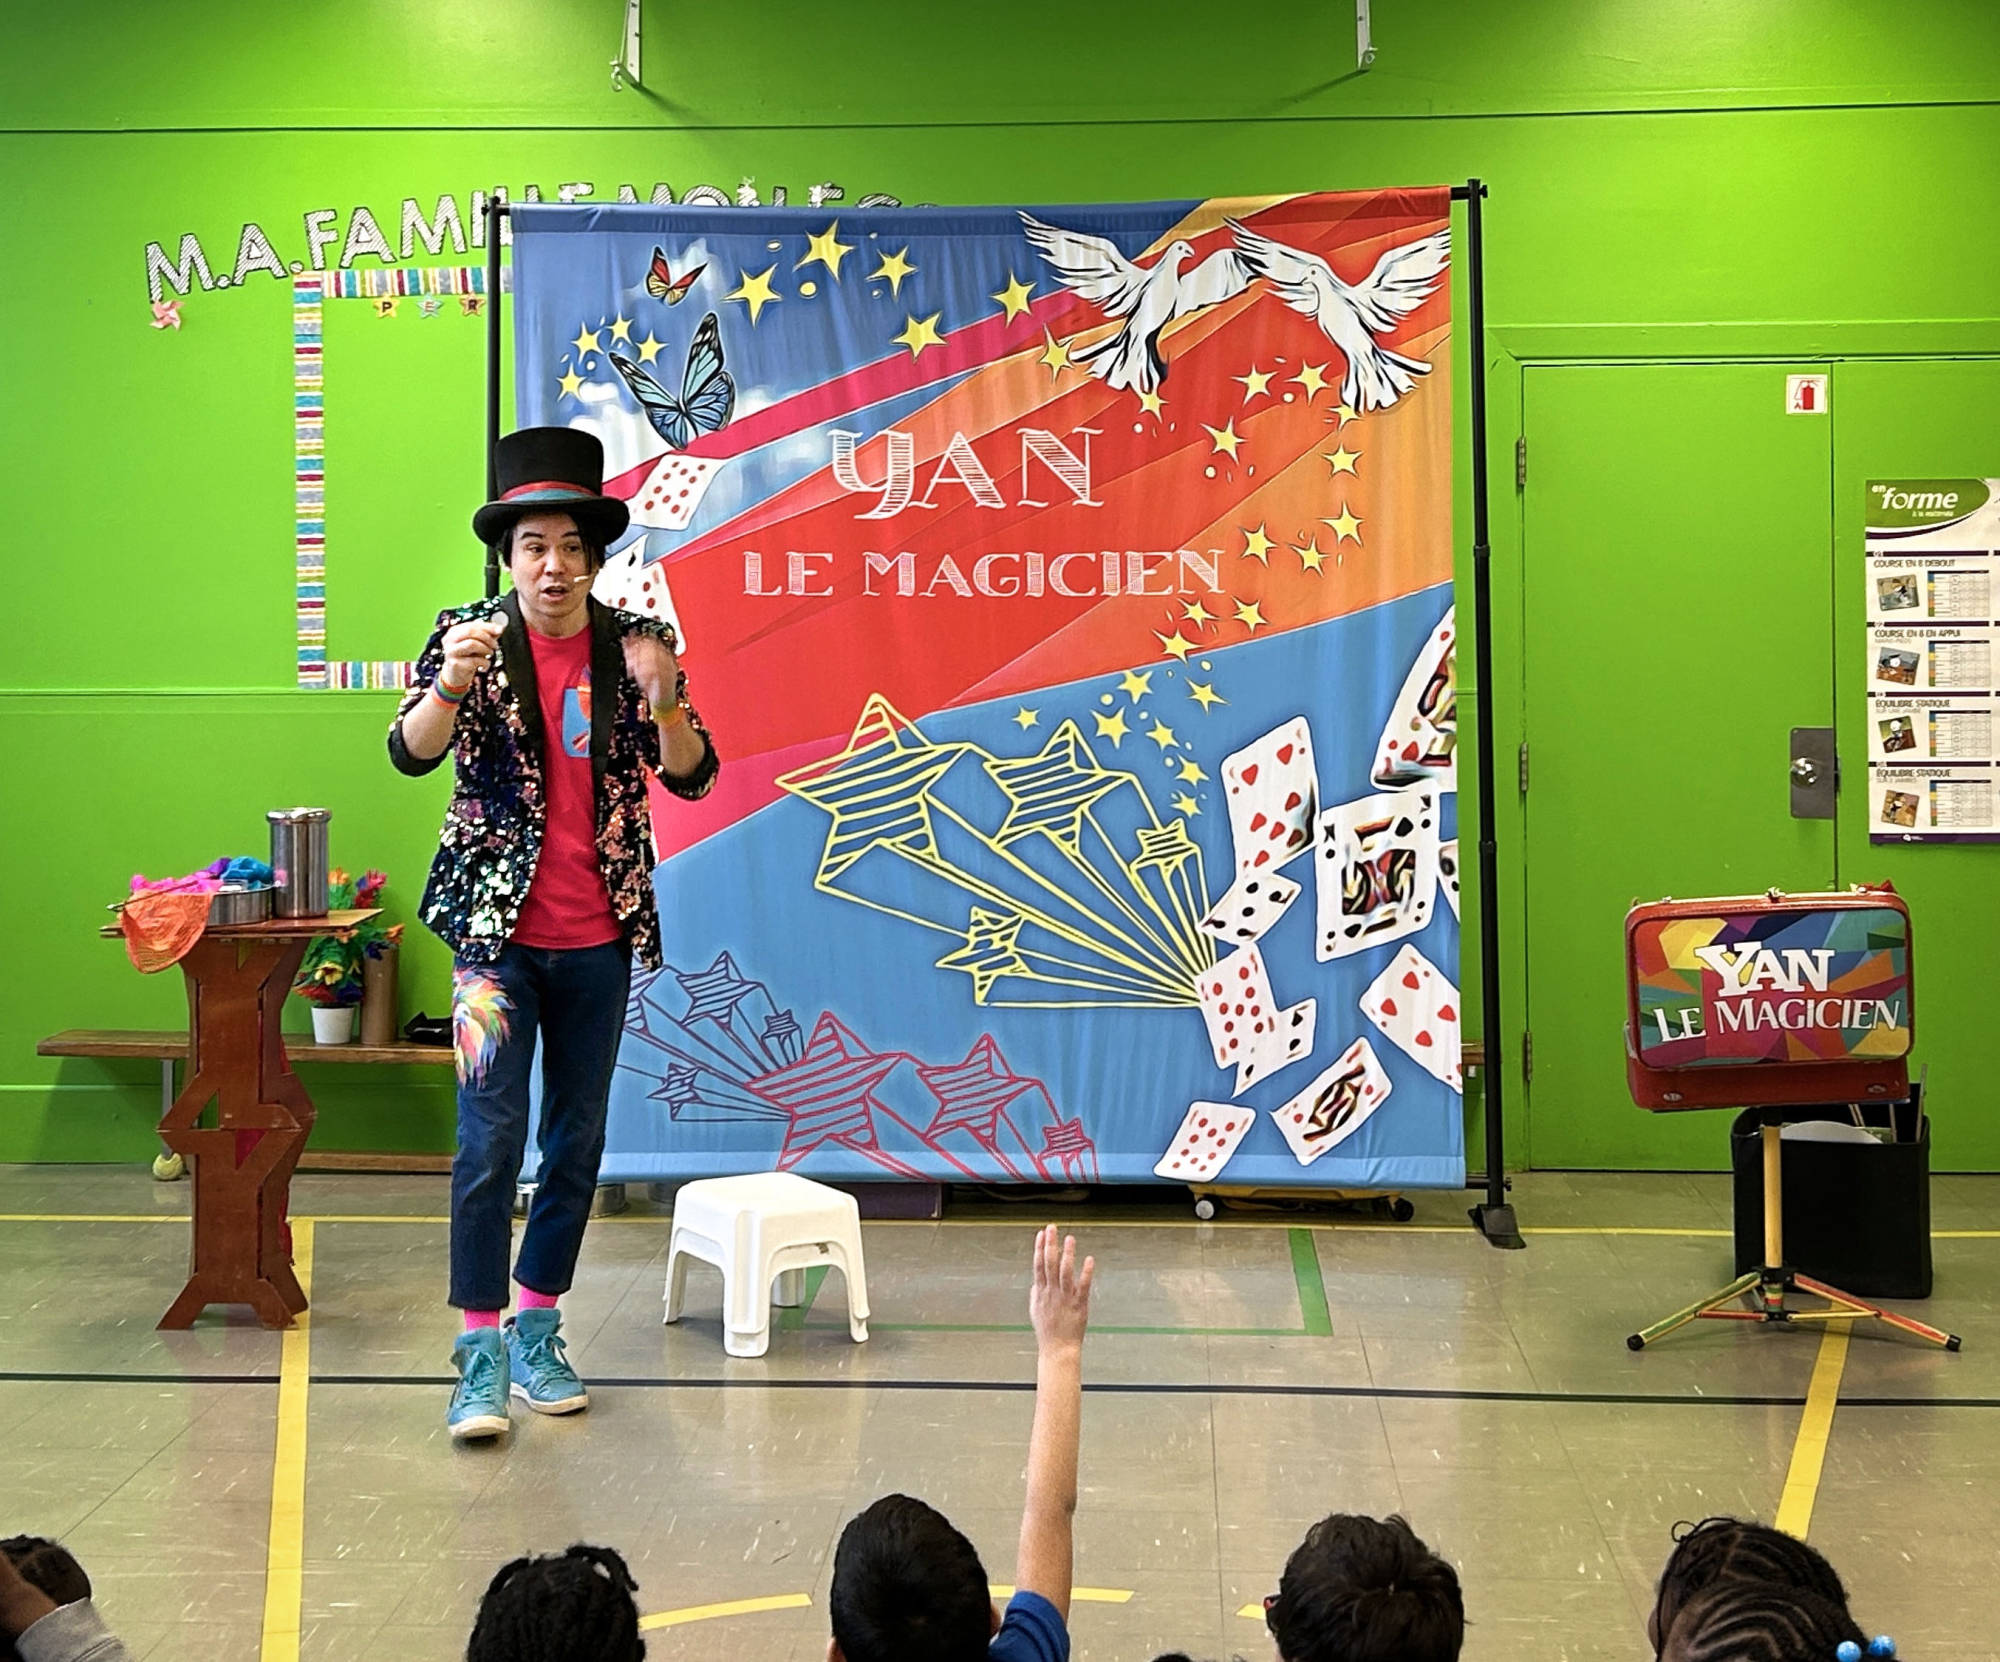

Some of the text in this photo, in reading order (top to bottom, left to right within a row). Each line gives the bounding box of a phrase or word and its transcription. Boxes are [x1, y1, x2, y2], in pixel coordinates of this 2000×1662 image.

[827, 428, 1104, 520] YAN
[1881, 487, 1959, 510] forme
[743, 549, 1226, 598] LE MAGICIEN
[1694, 941, 1835, 998] YAN
[1653, 997, 1900, 1043] LE MAGICIEN
